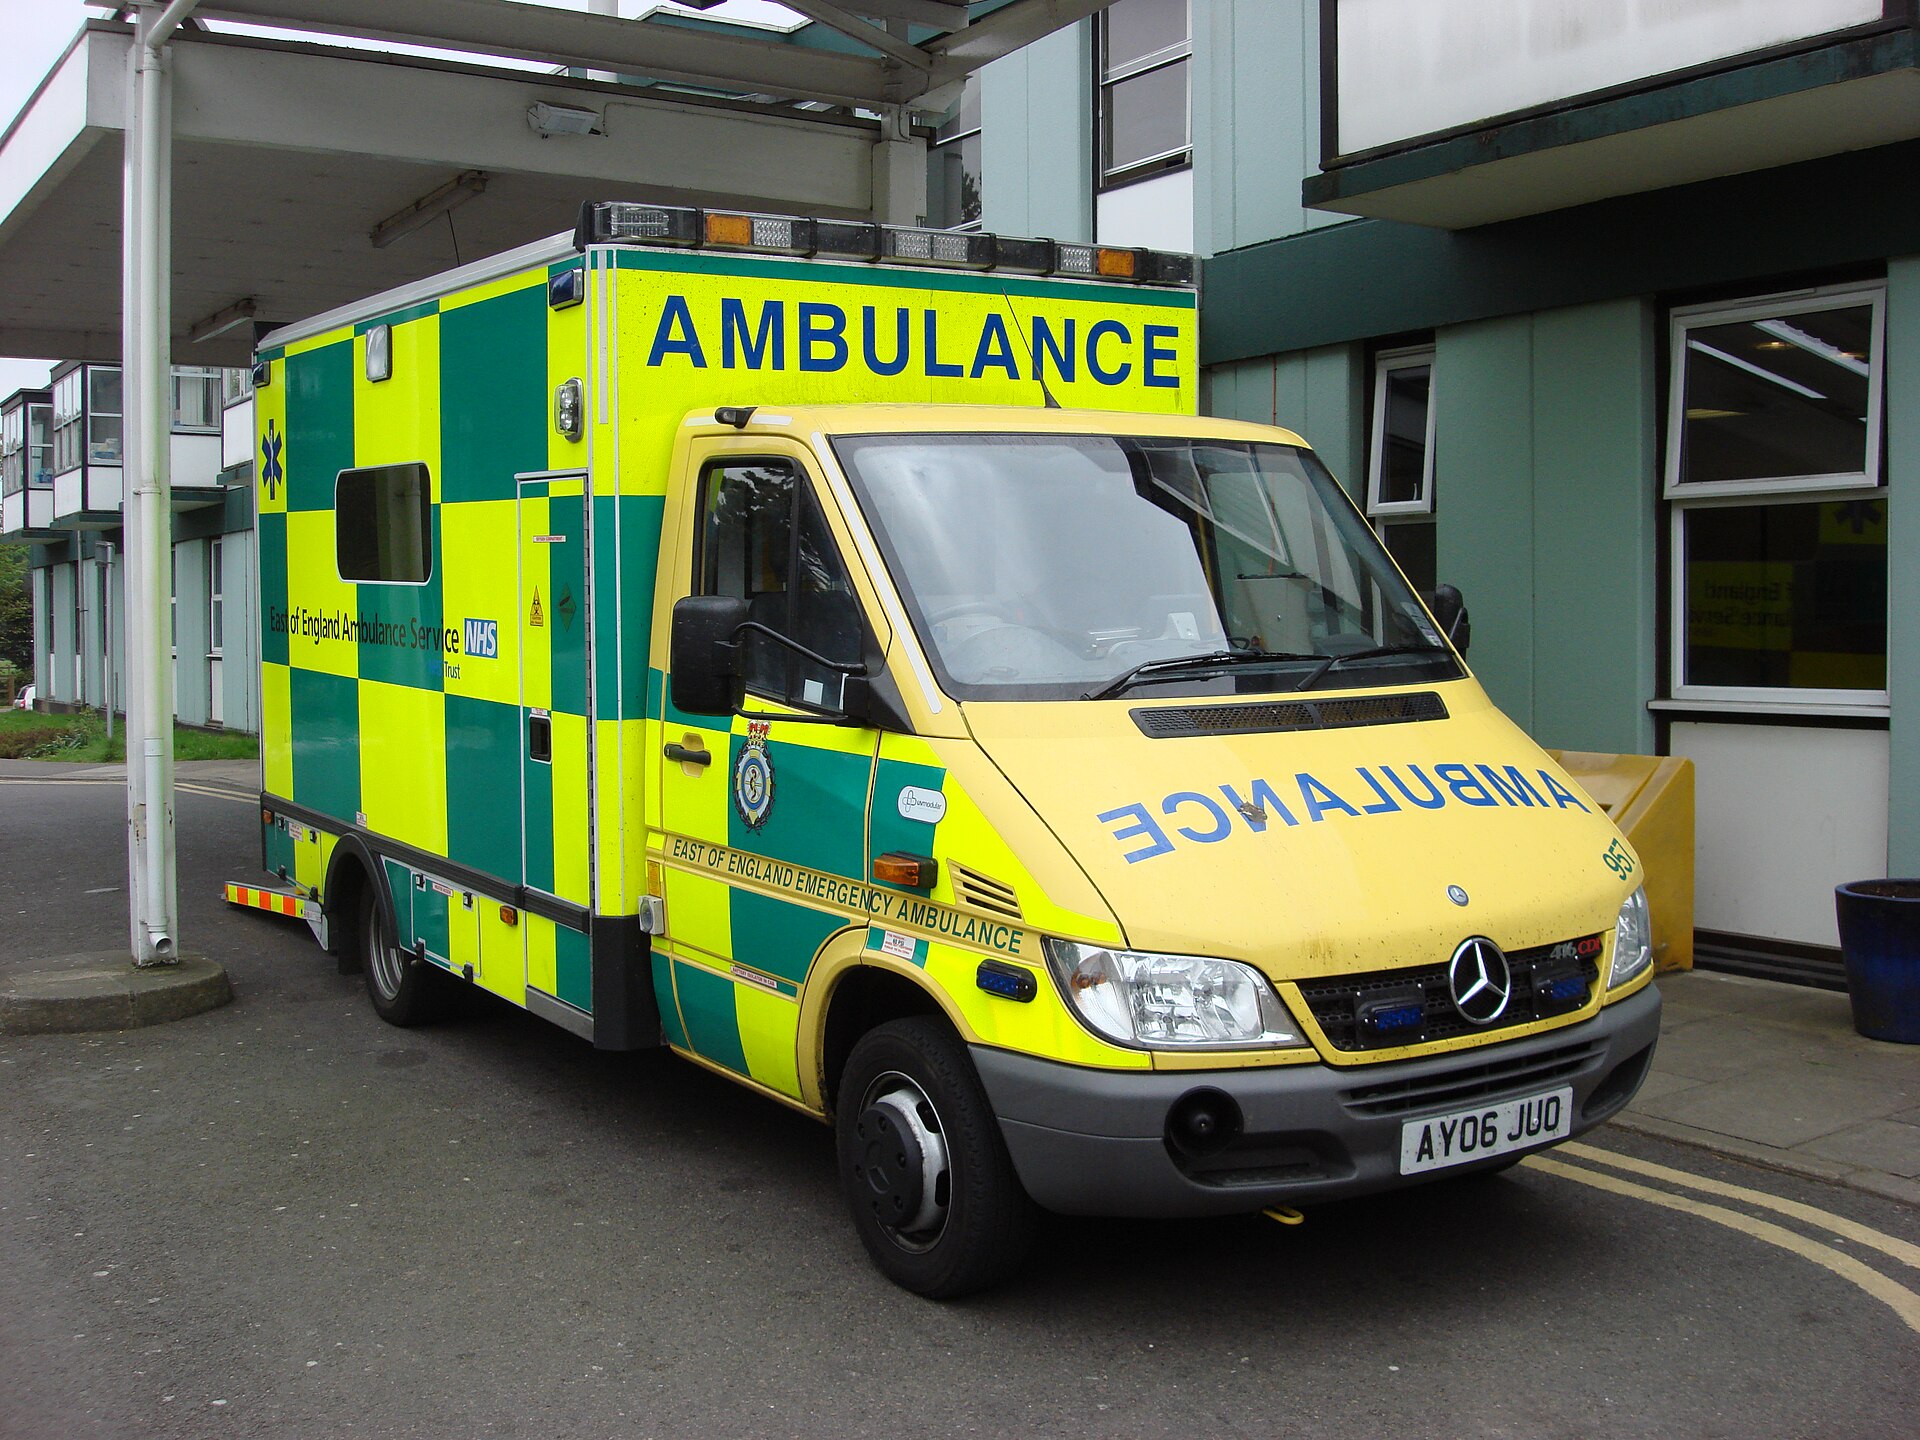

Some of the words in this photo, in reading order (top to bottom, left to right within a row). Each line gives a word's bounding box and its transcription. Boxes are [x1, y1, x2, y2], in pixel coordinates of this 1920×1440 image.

[646, 295, 1181, 389] AMBULANCE
[270, 606, 289, 634] East
[290, 607, 299, 634] of
[302, 608, 340, 645] England
[342, 612, 406, 647] Ambulance
[410, 617, 459, 654] Service
[465, 620, 496, 656] NHS
[444, 661, 460, 680] Trust
[1603, 837, 1635, 881] 957
[673, 839, 706, 863] EAST
[707, 846, 725, 868] OF
[728, 852, 793, 888] ENGLAND
[795, 869, 894, 913] EMERGENCY
[896, 899, 1024, 954] AMBULANCE
[1416, 1112, 1497, 1163] AY06
[1507, 1096, 1561, 1154] JUO
